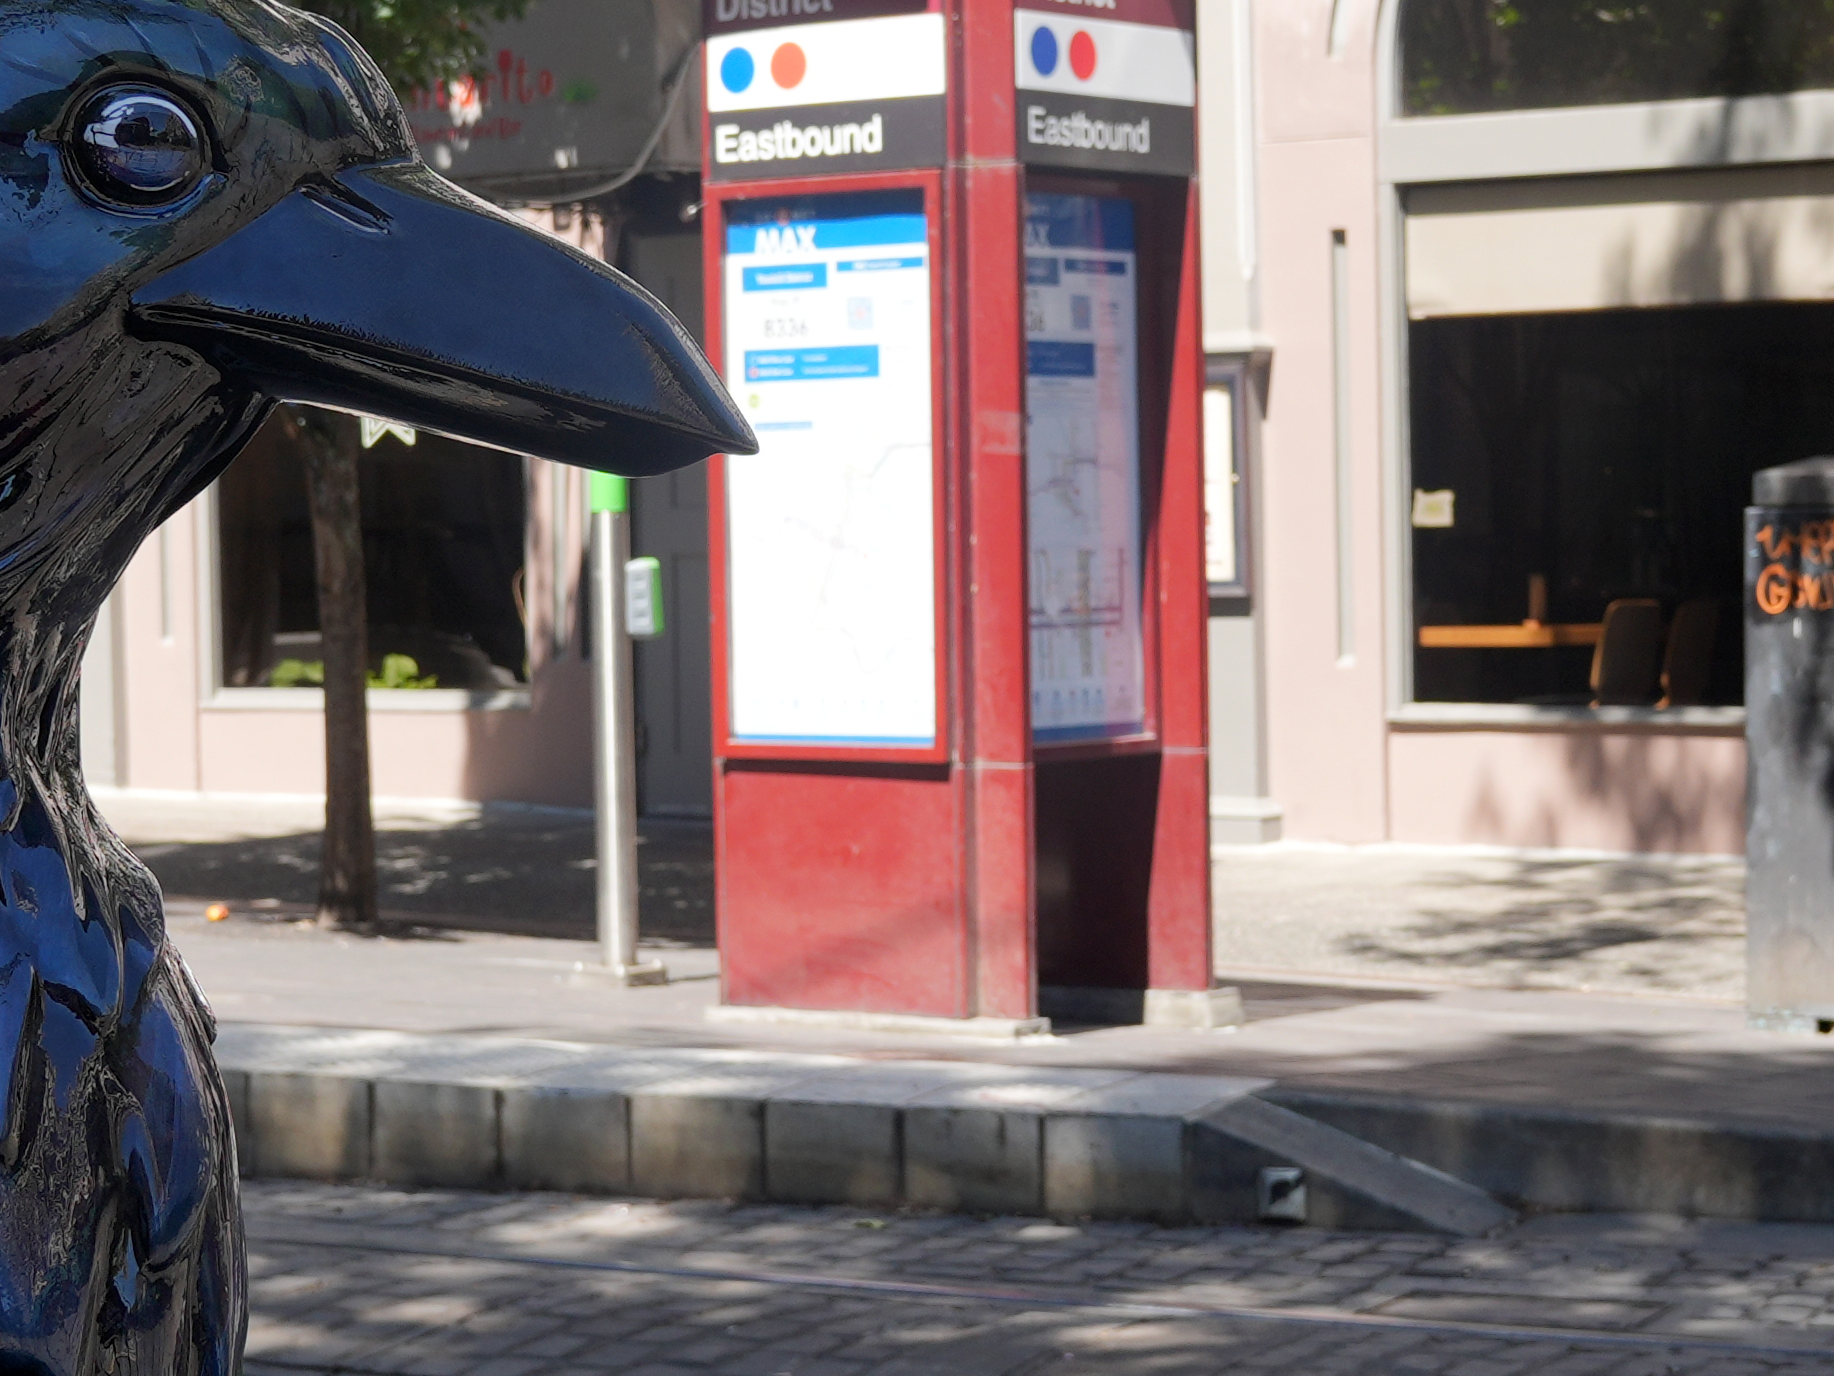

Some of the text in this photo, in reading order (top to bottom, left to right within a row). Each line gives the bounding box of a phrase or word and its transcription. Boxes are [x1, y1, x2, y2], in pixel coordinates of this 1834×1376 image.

[715, 113, 883, 164] Eastbound
[1027, 105, 1151, 154] Eastbound
[754, 225, 819, 254] MAX
